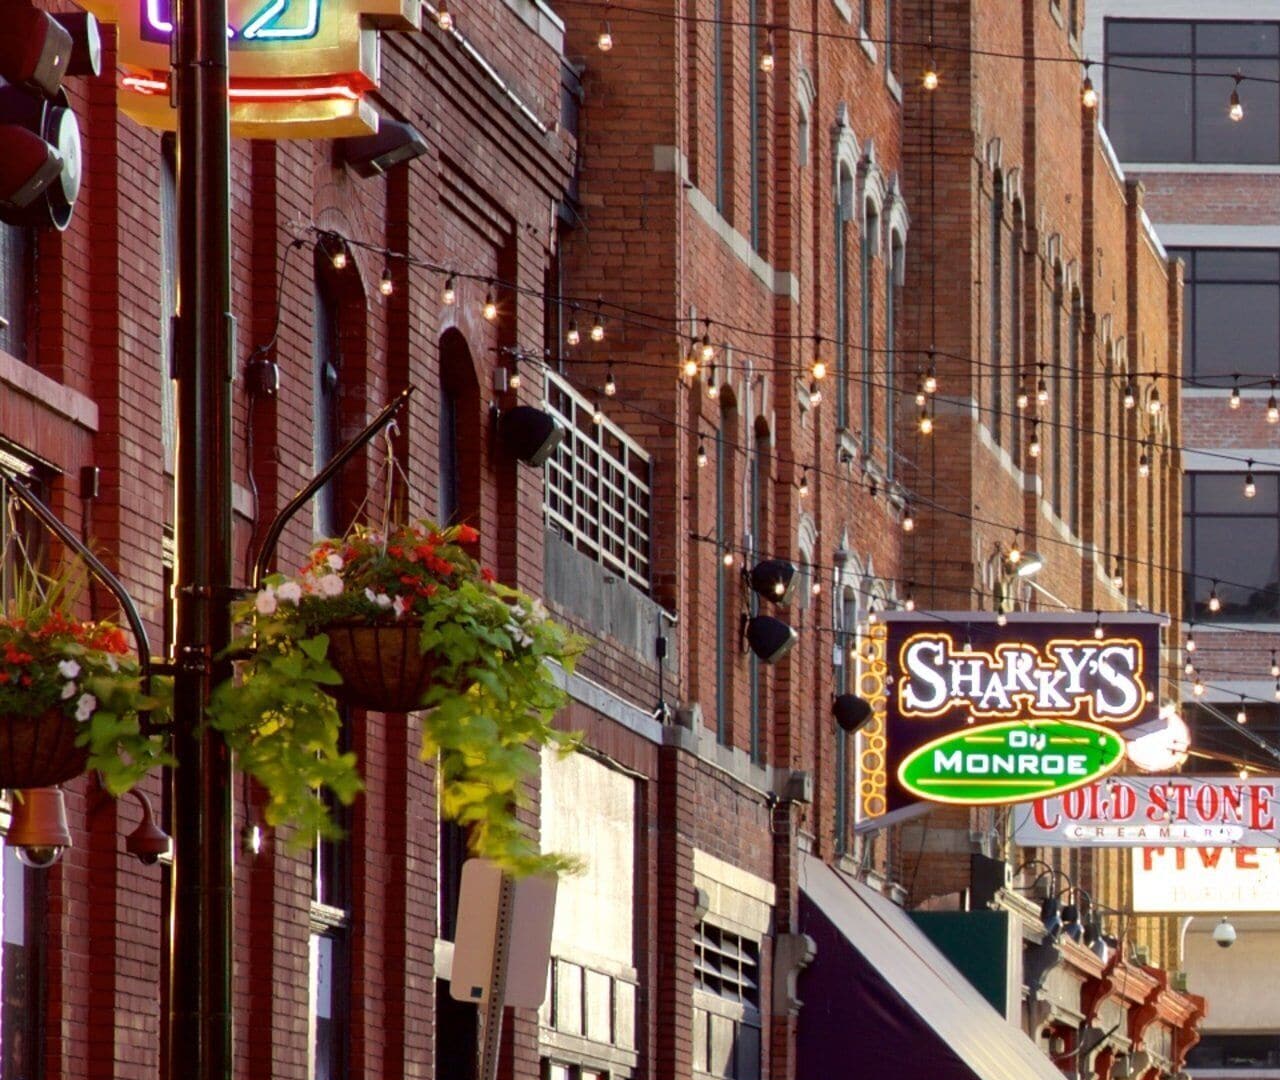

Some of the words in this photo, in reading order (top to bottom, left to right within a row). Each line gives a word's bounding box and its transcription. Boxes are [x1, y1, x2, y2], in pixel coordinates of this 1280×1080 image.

[901, 641, 1138, 717] SHARKY'S
[934, 750, 1088, 775] MONROE
[1032, 783, 1137, 831] COLD
[1145, 783, 1276, 831] STONE
